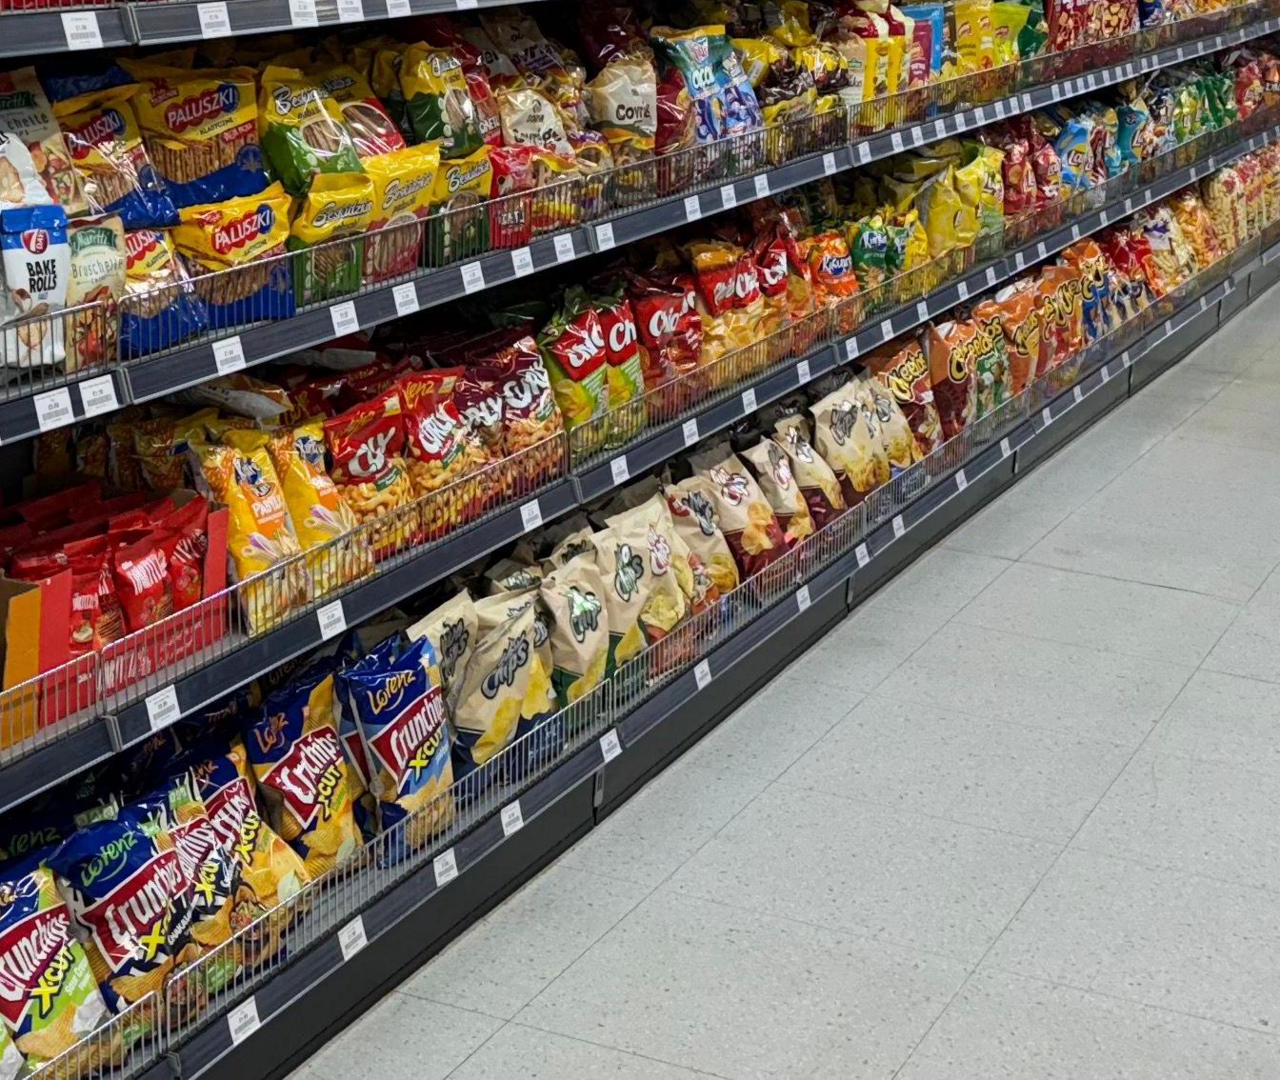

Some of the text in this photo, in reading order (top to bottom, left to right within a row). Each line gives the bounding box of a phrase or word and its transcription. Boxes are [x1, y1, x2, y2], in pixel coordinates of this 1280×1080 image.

[165, 85, 237, 130] PALUSZKI
[213, 205, 271, 254] PALUSZKI
[26, 258, 57, 277] BAKE
[28, 273, 58, 294] ROLLS
[366, 670, 417, 716] Lorenz
[390, 692, 446, 771] Crunchips
[408, 729, 444, 781] X-CUT
[80, 829, 138, 888] Lorenz
[104, 857, 183, 946] Crunchips
